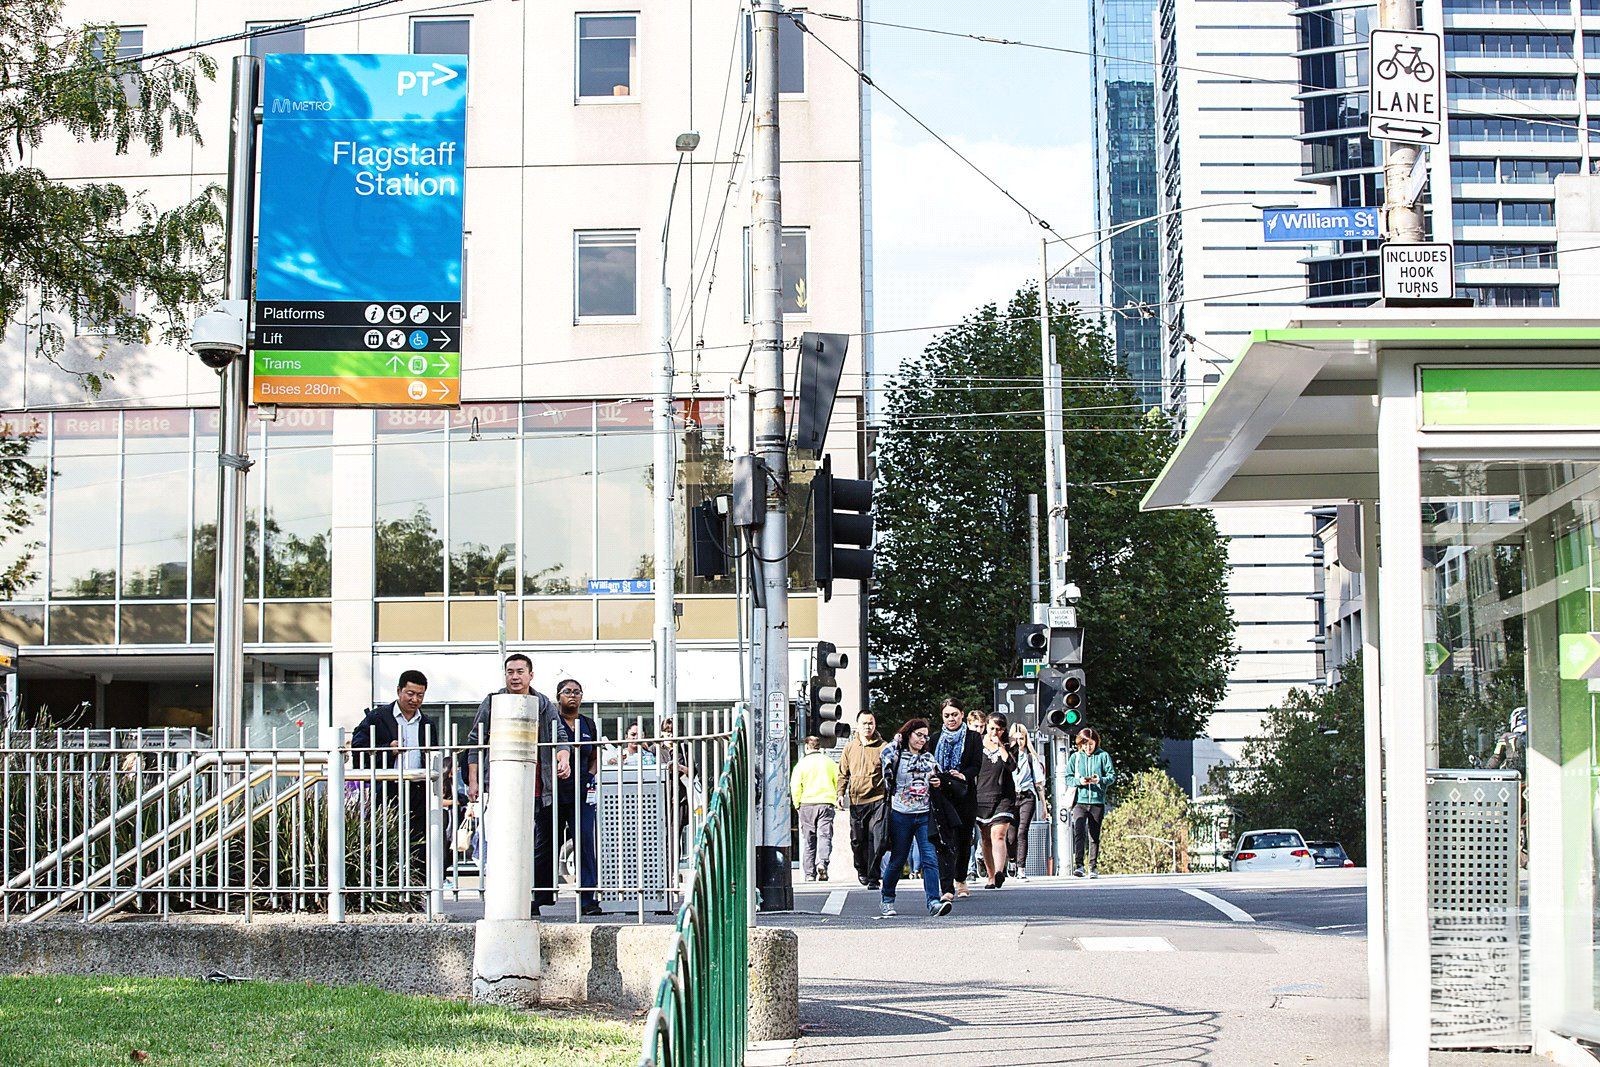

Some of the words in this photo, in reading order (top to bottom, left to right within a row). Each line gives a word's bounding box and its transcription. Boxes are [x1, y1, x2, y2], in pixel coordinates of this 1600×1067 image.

[292, 101, 333, 112] METRO
[1377, 91, 1434, 113] LANE
[333, 141, 457, 172] Flagstaff
[354, 171, 456, 196] Station
[1281, 212, 1349, 229] William
[1354, 211, 1375, 228] St
[1386, 251, 1447, 262] INCLUDES
[1400, 266, 1434, 278] HOOK
[1397, 281, 1439, 293] TURNS
[263, 307, 325, 320] Platforms
[262, 333, 283, 344] Lift
[262, 357, 302, 370] Trams
[261, 383, 301, 396] Buses
[304, 383, 342, 396] 280m
[387, 409, 445, 425] 8842
[454, 406, 509, 424] 3001
[65, 417, 106, 432] Real
[112, 416, 171, 432] Estate
[590, 580, 621, 590] William
